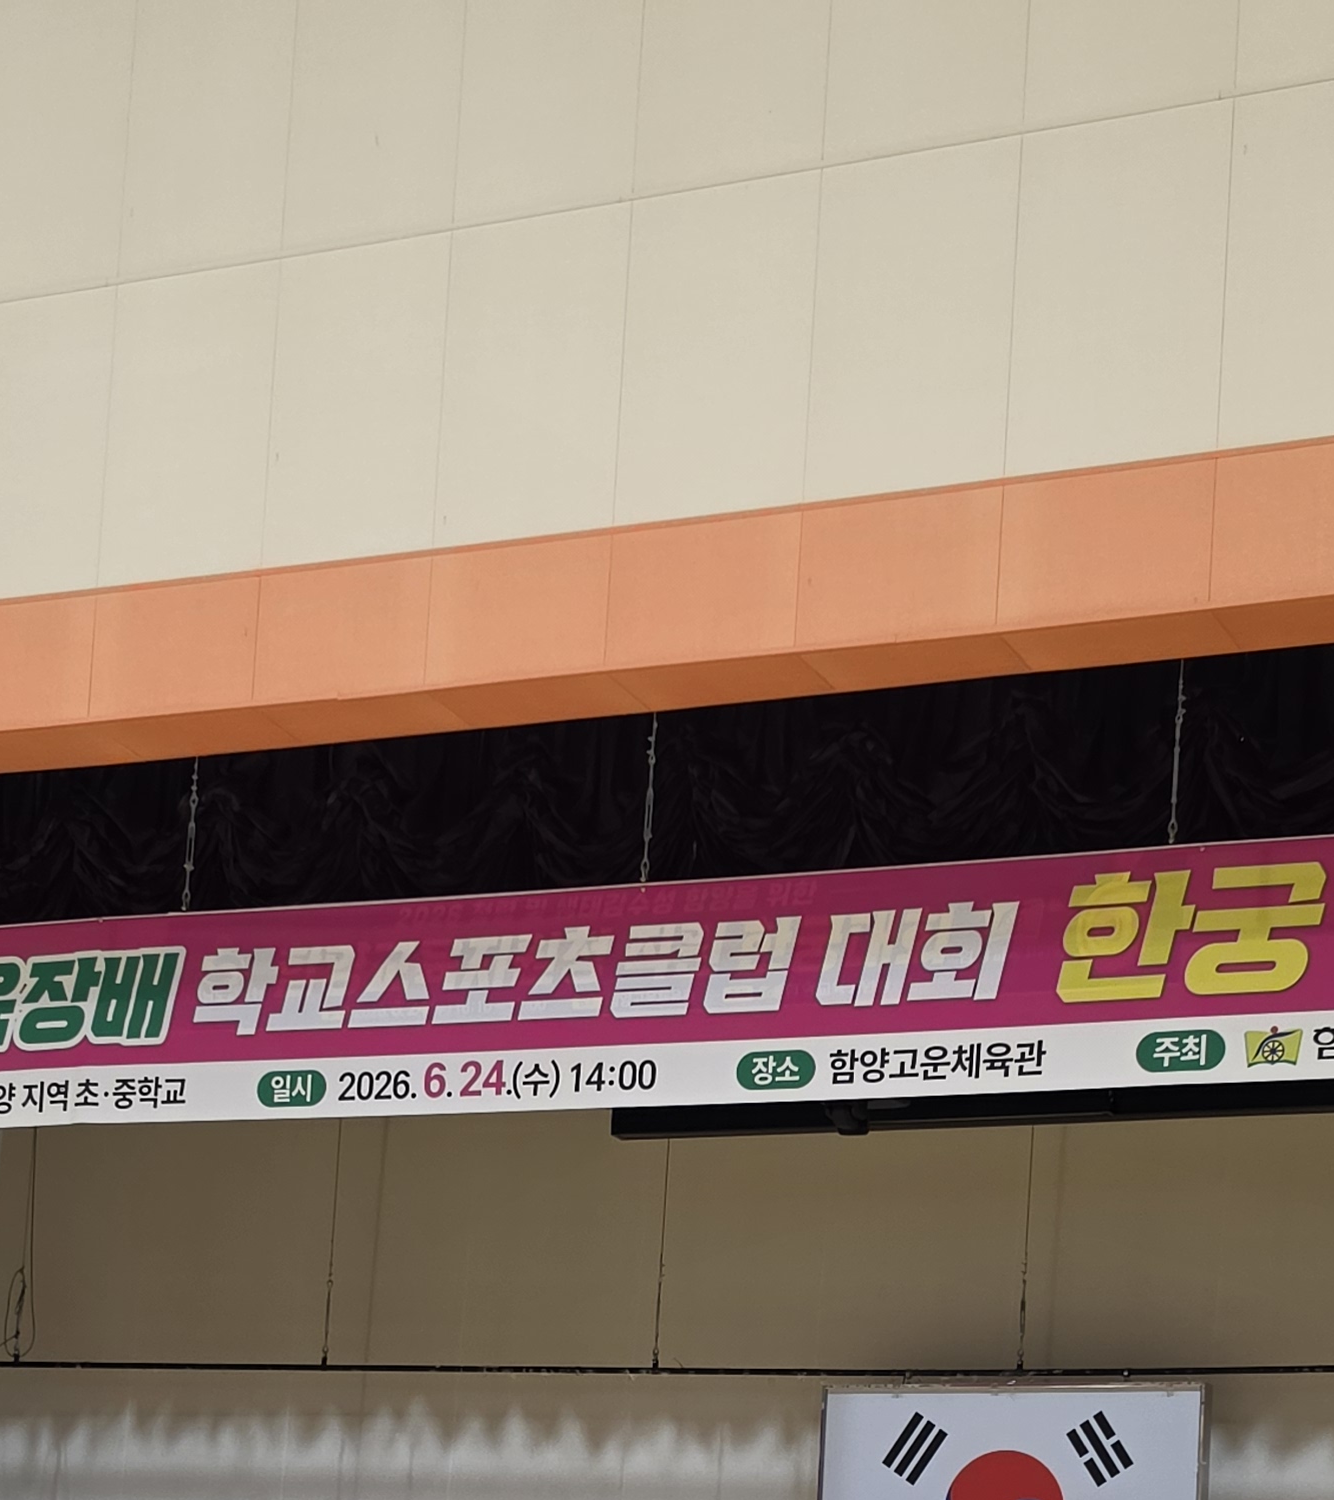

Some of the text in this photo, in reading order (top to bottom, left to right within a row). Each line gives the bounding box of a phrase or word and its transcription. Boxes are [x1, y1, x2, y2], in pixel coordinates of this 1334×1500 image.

[195, 915, 802, 1036] 학교스포츠클럽
[815, 901, 1020, 1007] 대회
[1055, 859, 1326, 1004] 한궁
[829, 1039, 1047, 1085] 함양고운체육관
[1152, 1034, 1208, 1067] 주최
[270, 1074, 313, 1102] 일시
[570, 1059, 657, 1093] 14:00
[751, 1056, 800, 1086] 장소
[22, 1080, 69, 1113] 지역
[74, 1076, 186, 1109] 초·중학교
